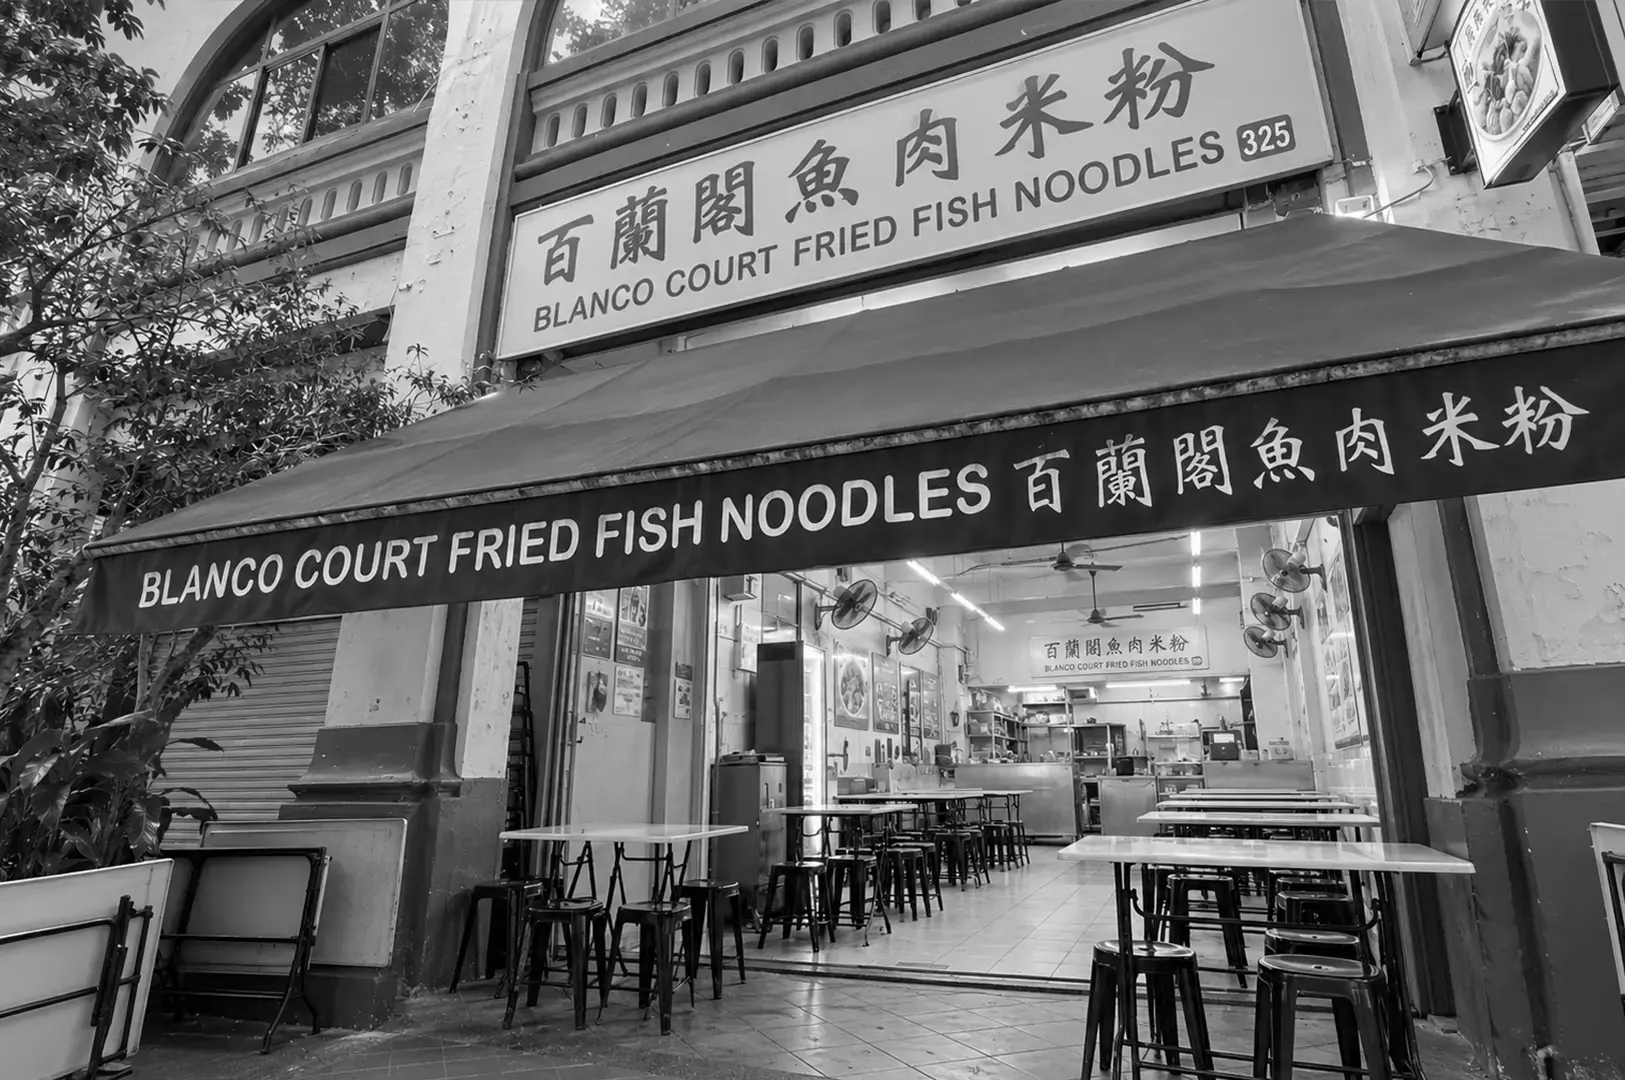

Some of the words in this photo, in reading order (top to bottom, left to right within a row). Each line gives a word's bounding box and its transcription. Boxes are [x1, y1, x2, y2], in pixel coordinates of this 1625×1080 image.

[534, 279, 654, 331] BLANCO
[666, 245, 779, 297] COURT
[794, 216, 897, 272] FRIED
[913, 188, 998, 237] FISH
[1015, 131, 1225, 212] NOODLES
[1242, 120, 1290, 155] 325
[538, 42, 1215, 286] 百蘭閣魚肉米粉
[139, 555, 284, 609] BLANCO
[295, 534, 438, 589] COURT
[449, 518, 579, 573] FRIED
[596, 500, 702, 558] FISH
[721, 463, 991, 543] NOODLES
[1014, 385, 1590, 514] 百蘭閣魚肉米粉
[1044, 634, 1188, 659] 百蘭閣魚肉米粉
[1044, 663, 1075, 672] BLANCO
[1077, 661, 1103, 671] COURT
[1106, 660, 1128, 669] FRIED
[1130, 659, 1148, 668] FISH
[1150, 657, 1189, 667] NOODLES
